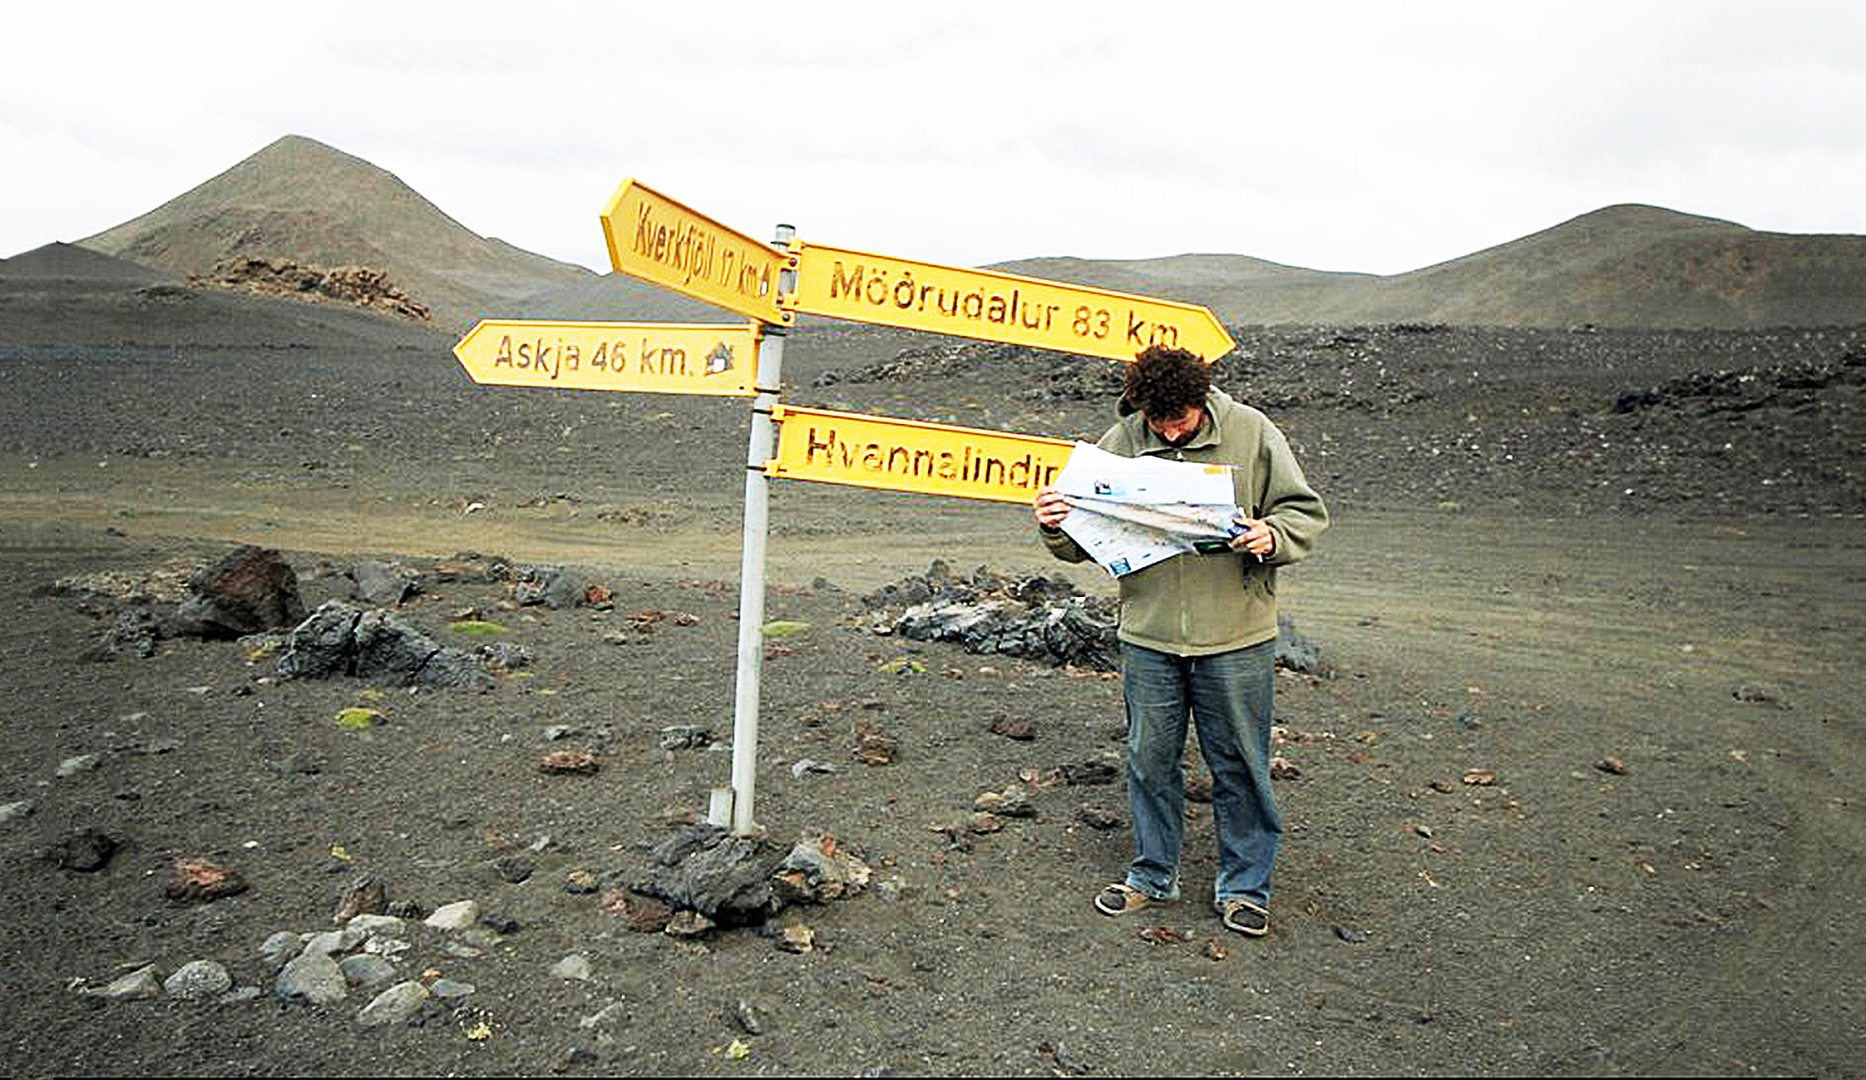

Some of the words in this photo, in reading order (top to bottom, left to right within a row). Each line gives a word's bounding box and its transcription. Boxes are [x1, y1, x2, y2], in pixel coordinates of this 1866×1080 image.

[721, 247, 735, 287] 17
[1072, 305, 1111, 339] 83
[1127, 309, 1179, 347] km
[494, 335, 580, 380] Askja
[591, 341, 627, 374] 46
[640, 338, 694, 377] km.
[806, 427, 1059, 489] Hvannalindir
